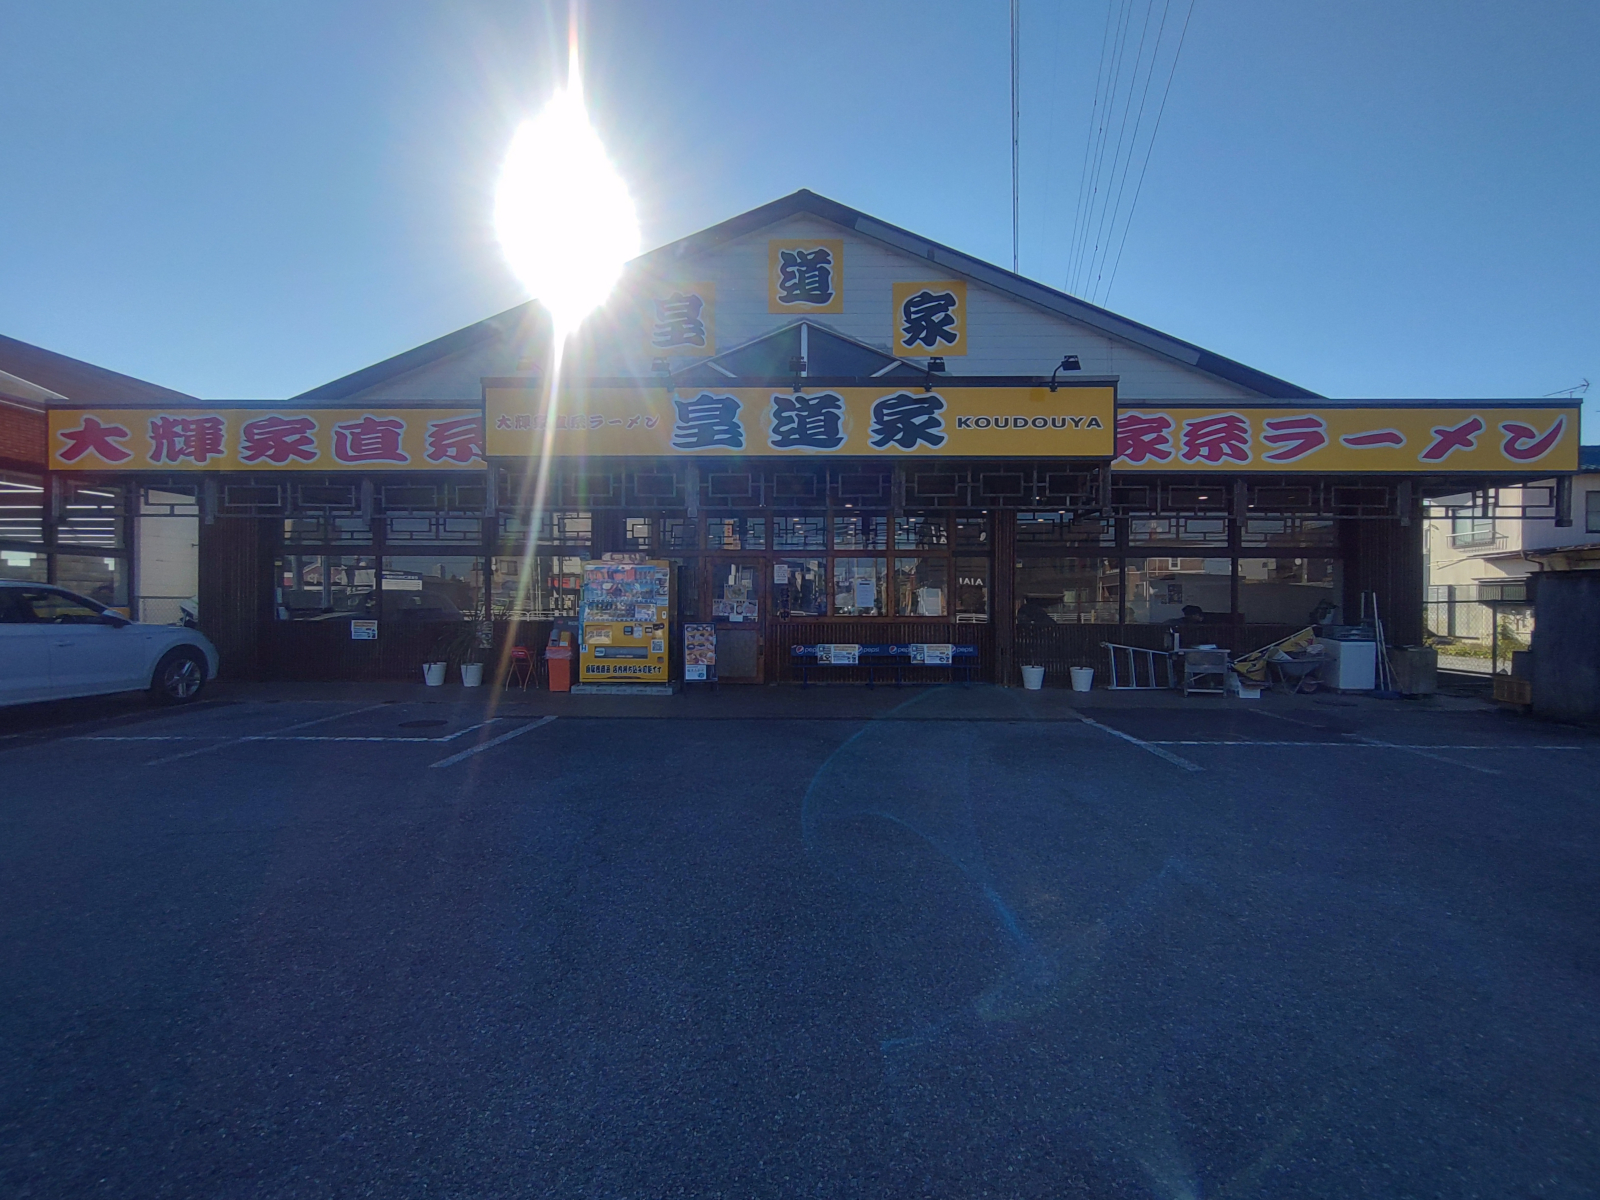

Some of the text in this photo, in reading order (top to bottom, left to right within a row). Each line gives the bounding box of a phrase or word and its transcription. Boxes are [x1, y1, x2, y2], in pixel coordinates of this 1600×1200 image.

[652, 247, 958, 348] 皇 道 家
[672, 393, 947, 450] 皇道家
[957, 416, 1102, 429] KOUDOUYA
[1117, 414, 1566, 463] 家系ラーメン
[863, 646, 880, 654] pepsi
[957, 646, 974, 654] pepsi
